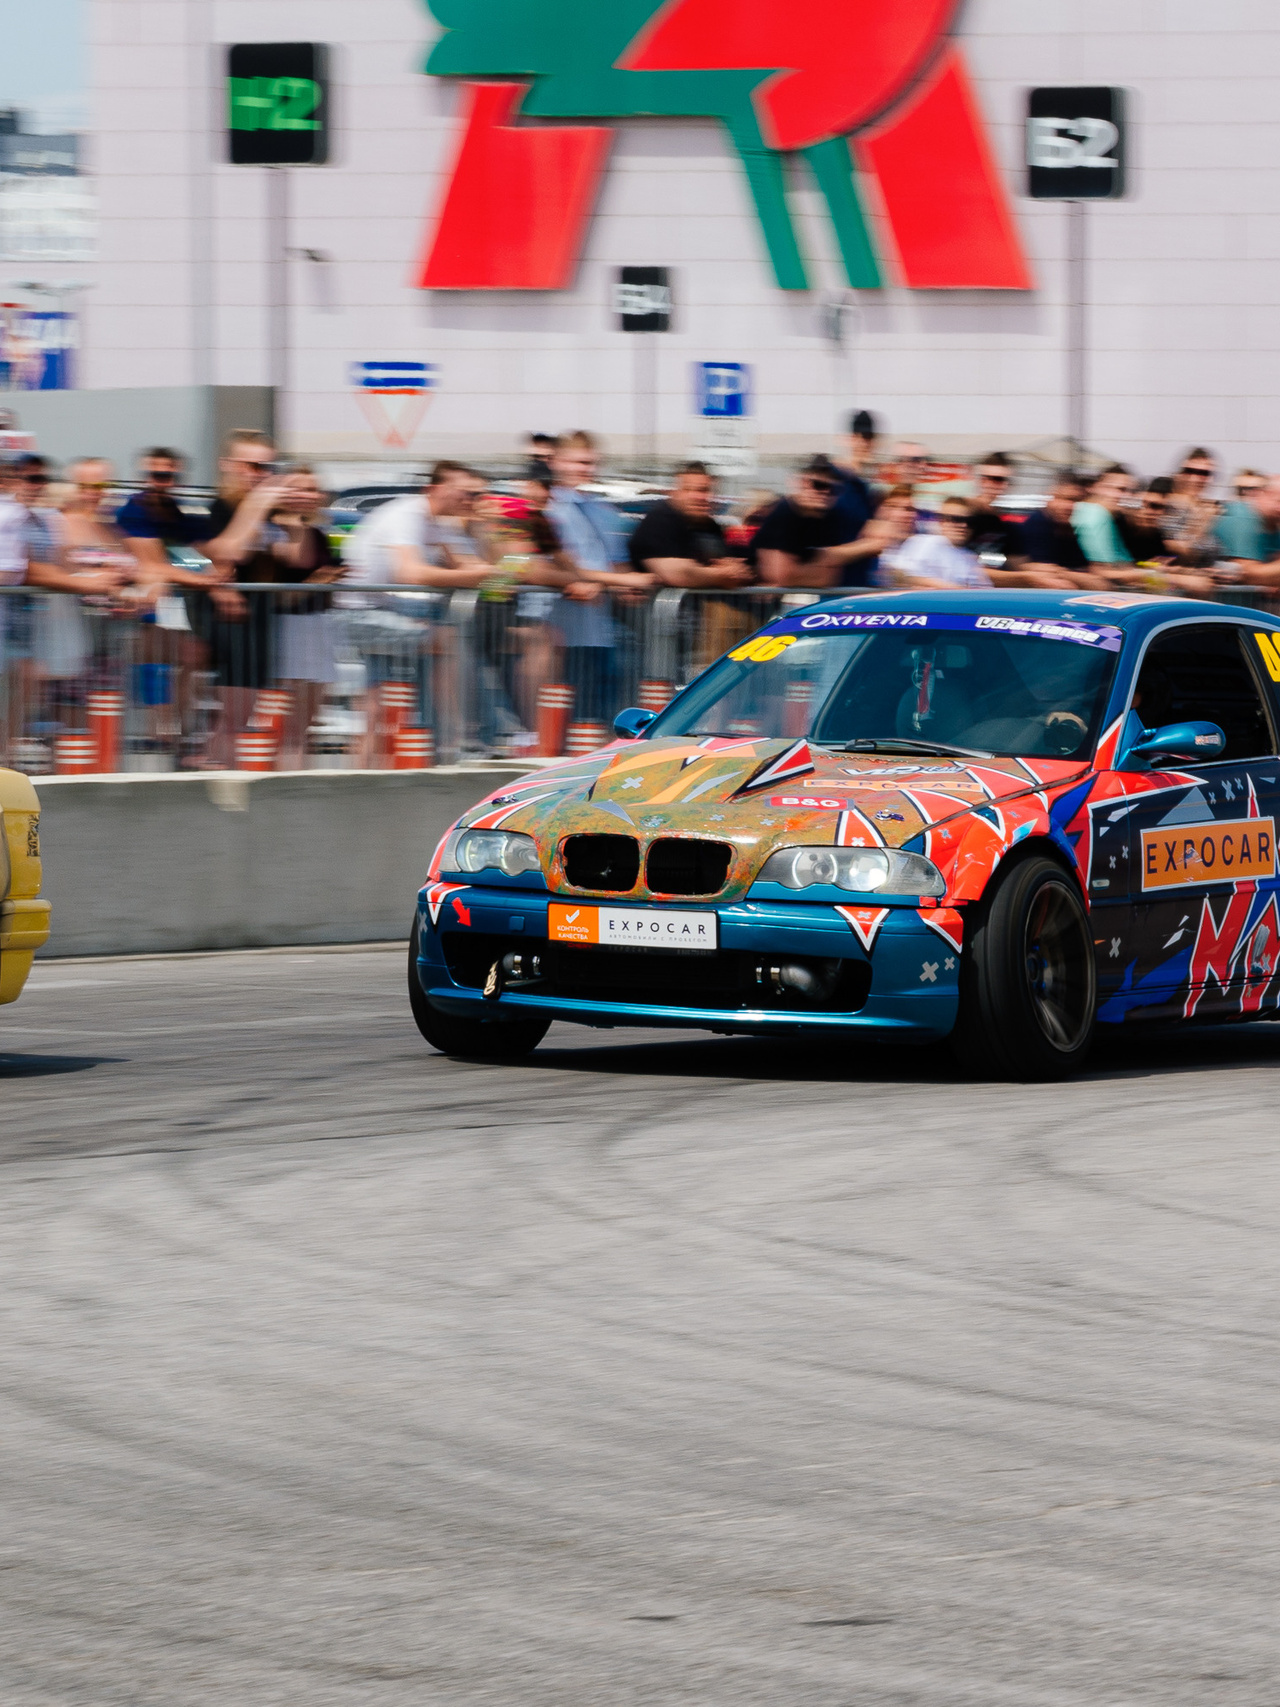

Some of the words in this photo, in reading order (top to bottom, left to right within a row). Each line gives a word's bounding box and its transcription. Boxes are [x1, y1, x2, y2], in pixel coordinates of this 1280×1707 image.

[727, 635, 797, 662] 46
[811, 780, 973, 790] EXPOCAR
[781, 797, 841, 808] B&G
[1146, 831, 1271, 875] EXPOCAR
[608, 919, 706, 935] EXPOCAR
